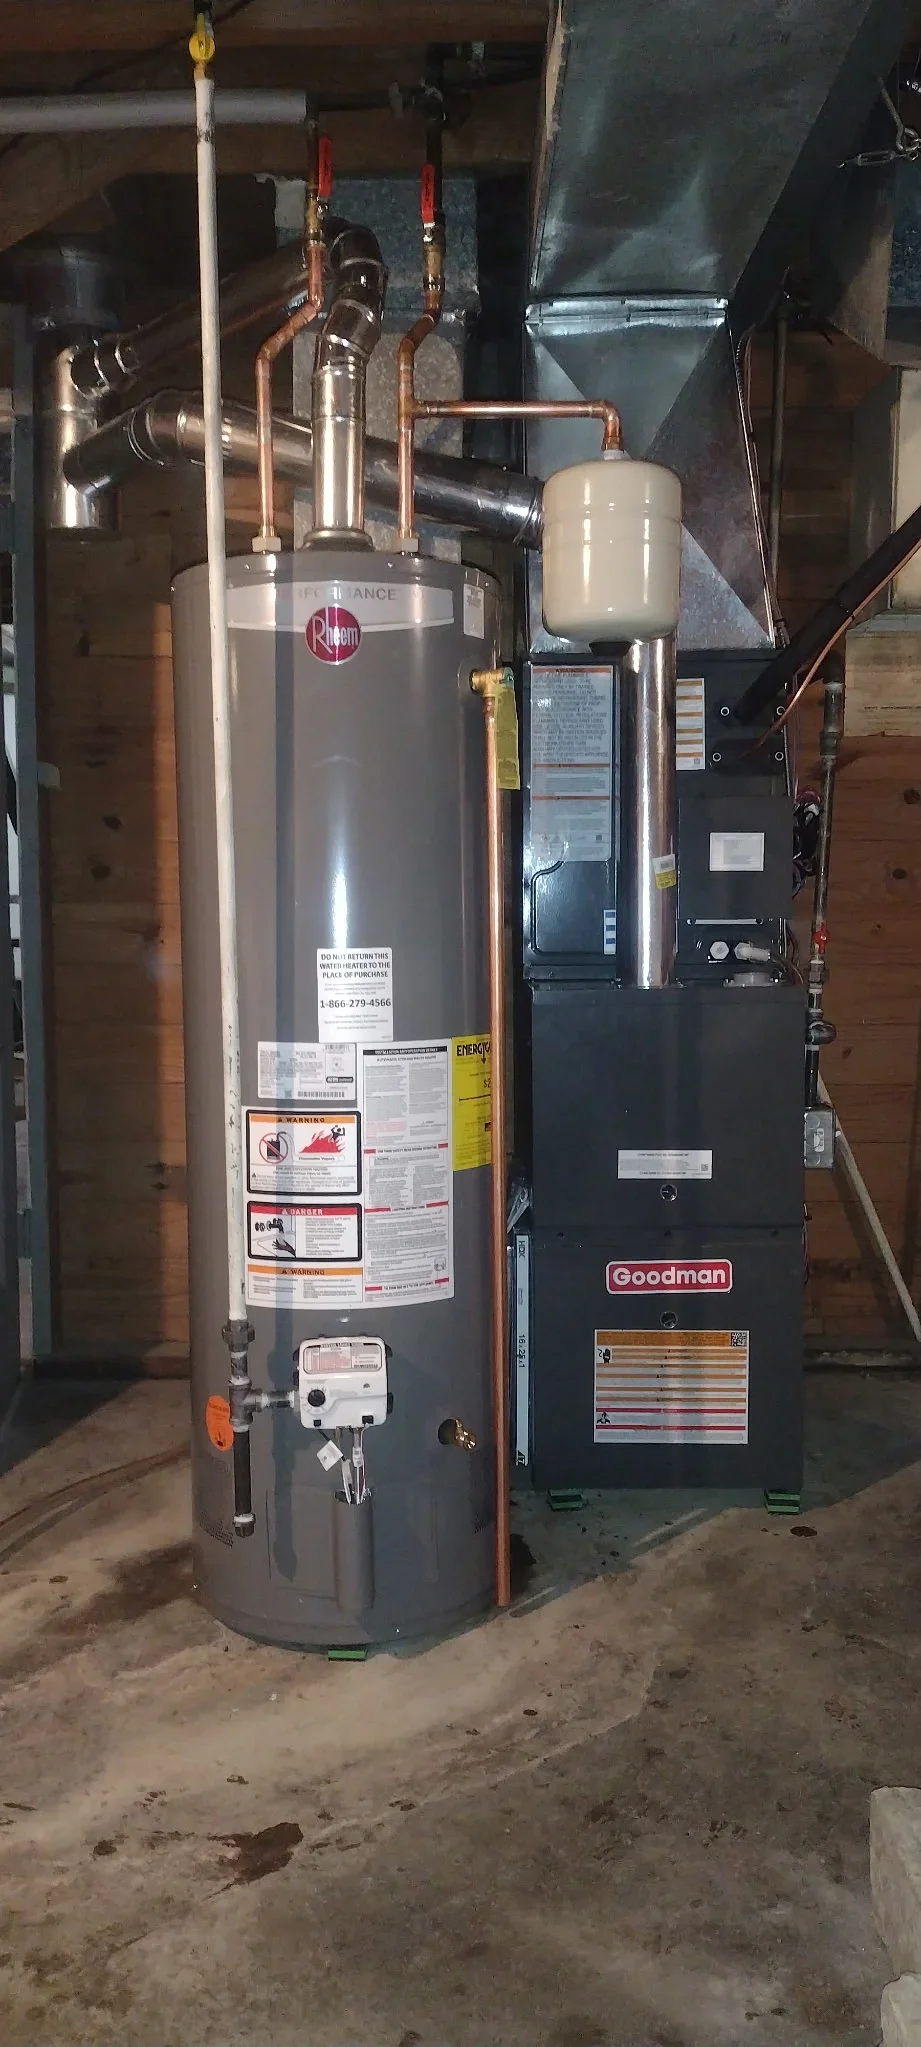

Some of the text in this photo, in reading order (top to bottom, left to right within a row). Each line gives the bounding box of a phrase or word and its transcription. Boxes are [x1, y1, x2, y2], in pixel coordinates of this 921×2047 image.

[312, 607, 359, 654] Rheem
[321, 953, 331, 961] DO
[320, 962, 342, 970] WATER
[320, 999, 391, 1009] 1-866-279-4566
[518, 1240, 526, 1258] HDX
[612, 1267, 726, 1286] Goodman
